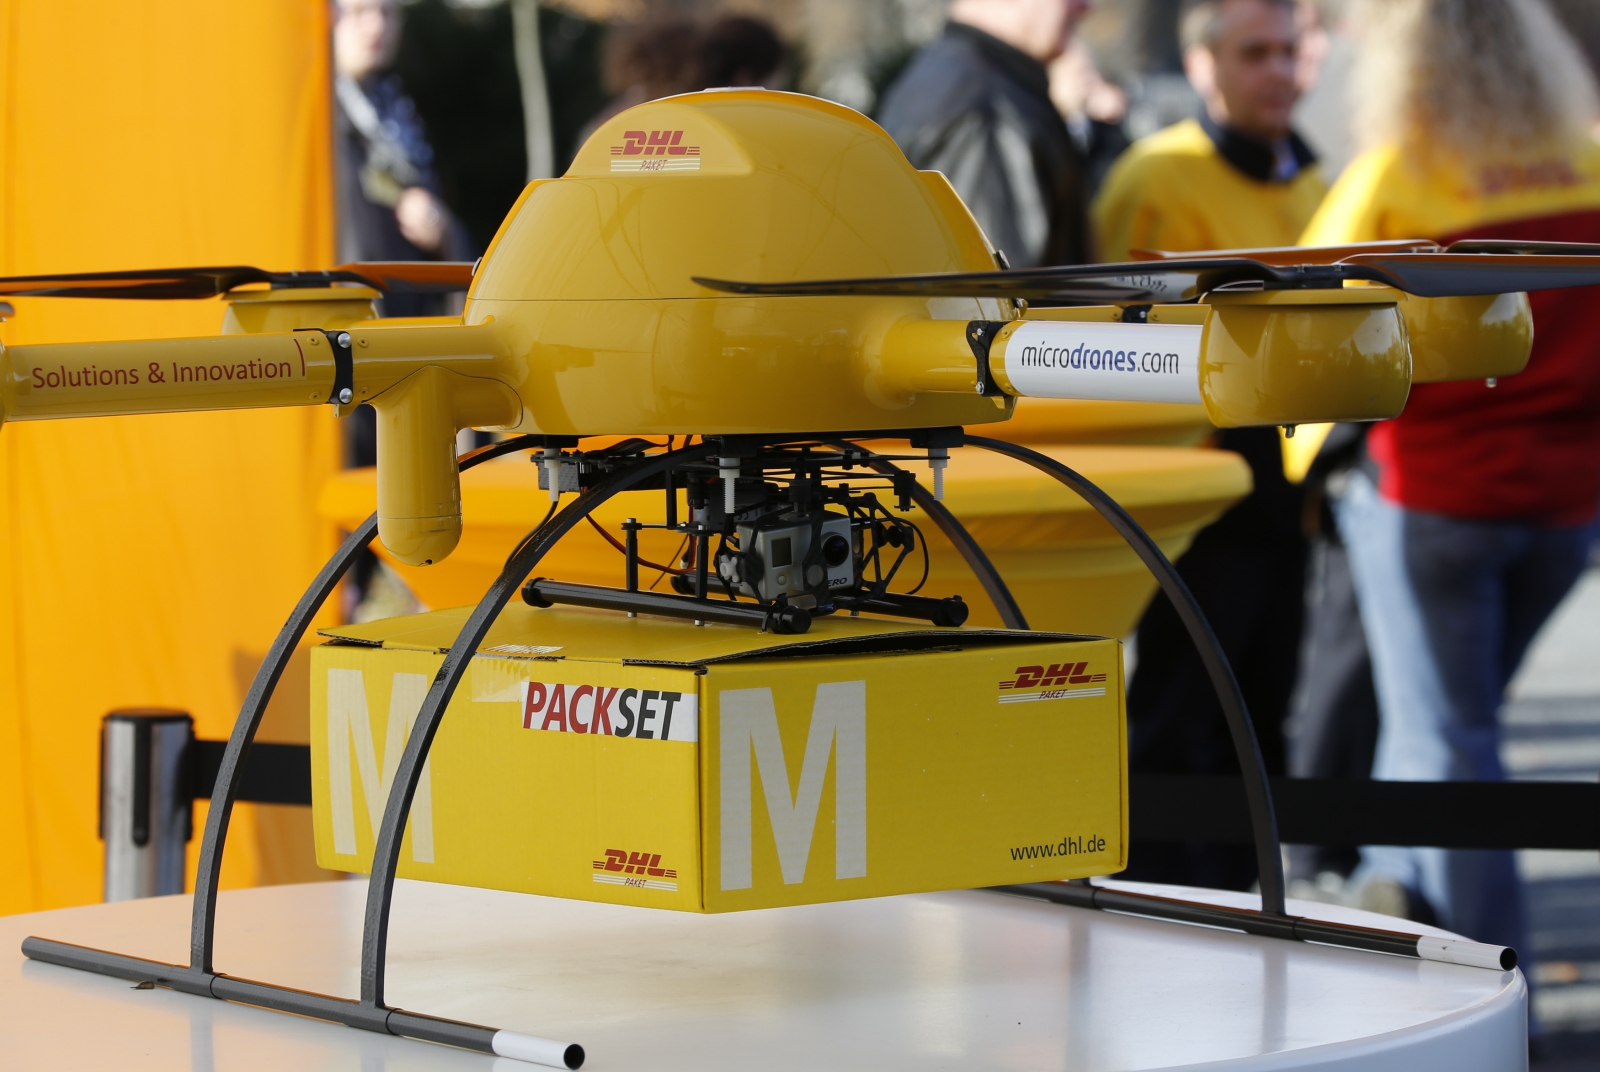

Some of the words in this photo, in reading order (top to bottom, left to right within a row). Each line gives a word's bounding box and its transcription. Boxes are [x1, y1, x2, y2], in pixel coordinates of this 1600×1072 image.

[622, 130, 688, 155] DHL
[639, 159, 668, 171] PAKET
[1021, 340, 1179, 374] microdrones.com
[32, 365, 139, 388] Solutions
[148, 362, 165, 384] &
[172, 358, 291, 383] Innovation
[827, 577, 848, 587] ERO
[1014, 661, 1092, 689] DHL
[1039, 688, 1068, 700] PAKET
[523, 681, 682, 741] PACKSET
[327, 668, 434, 863] M
[719, 680, 867, 891] M
[1010, 834, 1106, 861] www.dhl.de
[604, 848, 666, 877] DHL
[624, 877, 647, 889] PAKET
